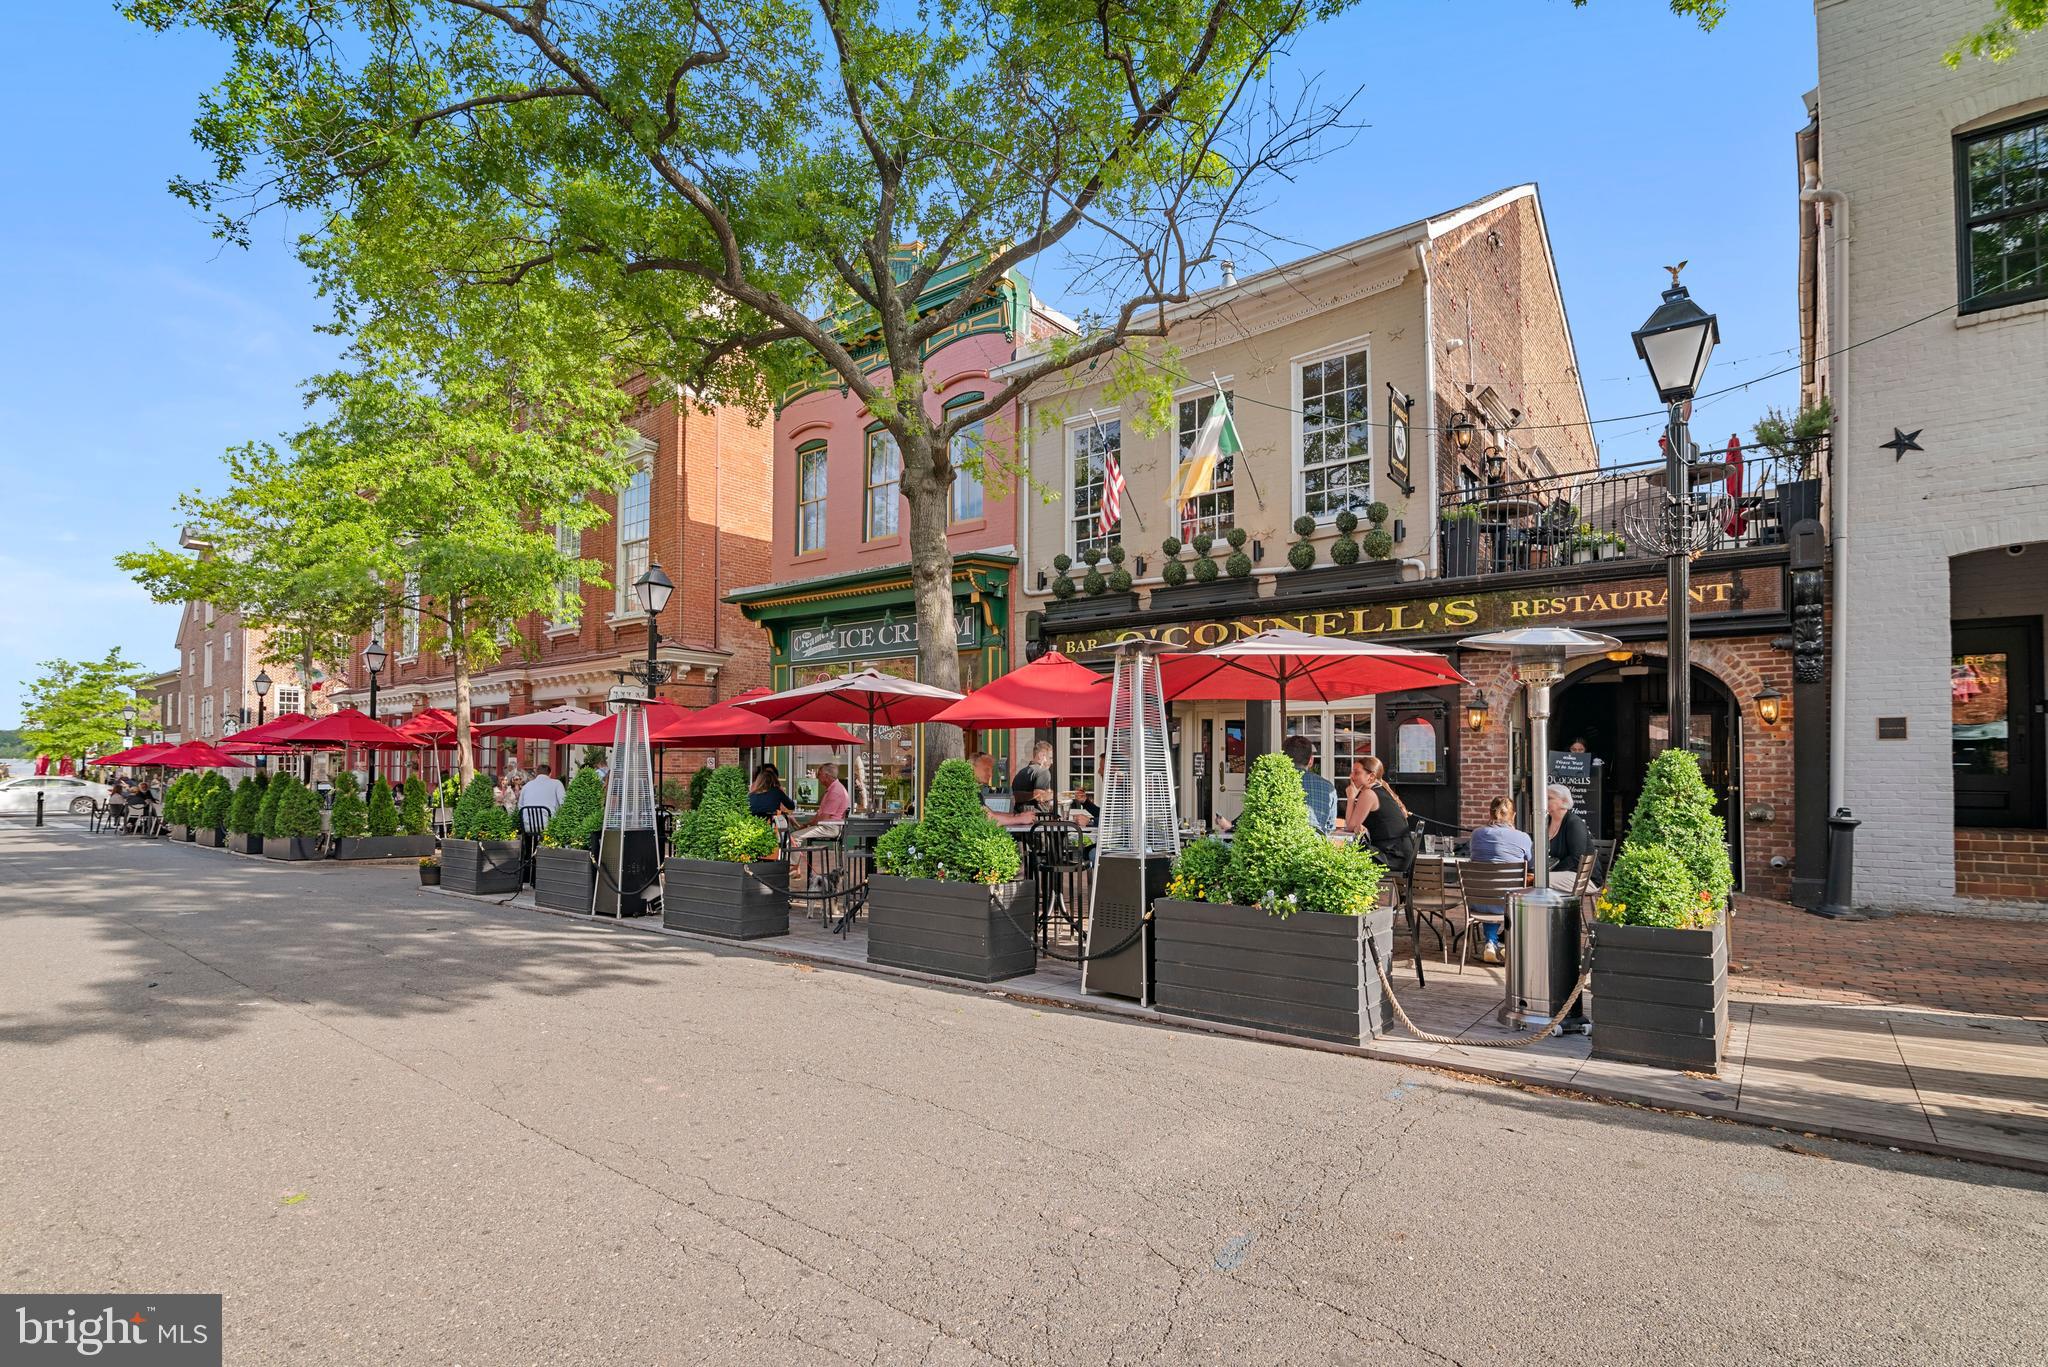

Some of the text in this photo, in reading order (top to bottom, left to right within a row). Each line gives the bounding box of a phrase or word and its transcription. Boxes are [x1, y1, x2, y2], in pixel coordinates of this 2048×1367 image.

[838, 627, 875, 649] ICE
[878, 615, 972, 646] CRM
[1065, 639, 1098, 654] BAR
